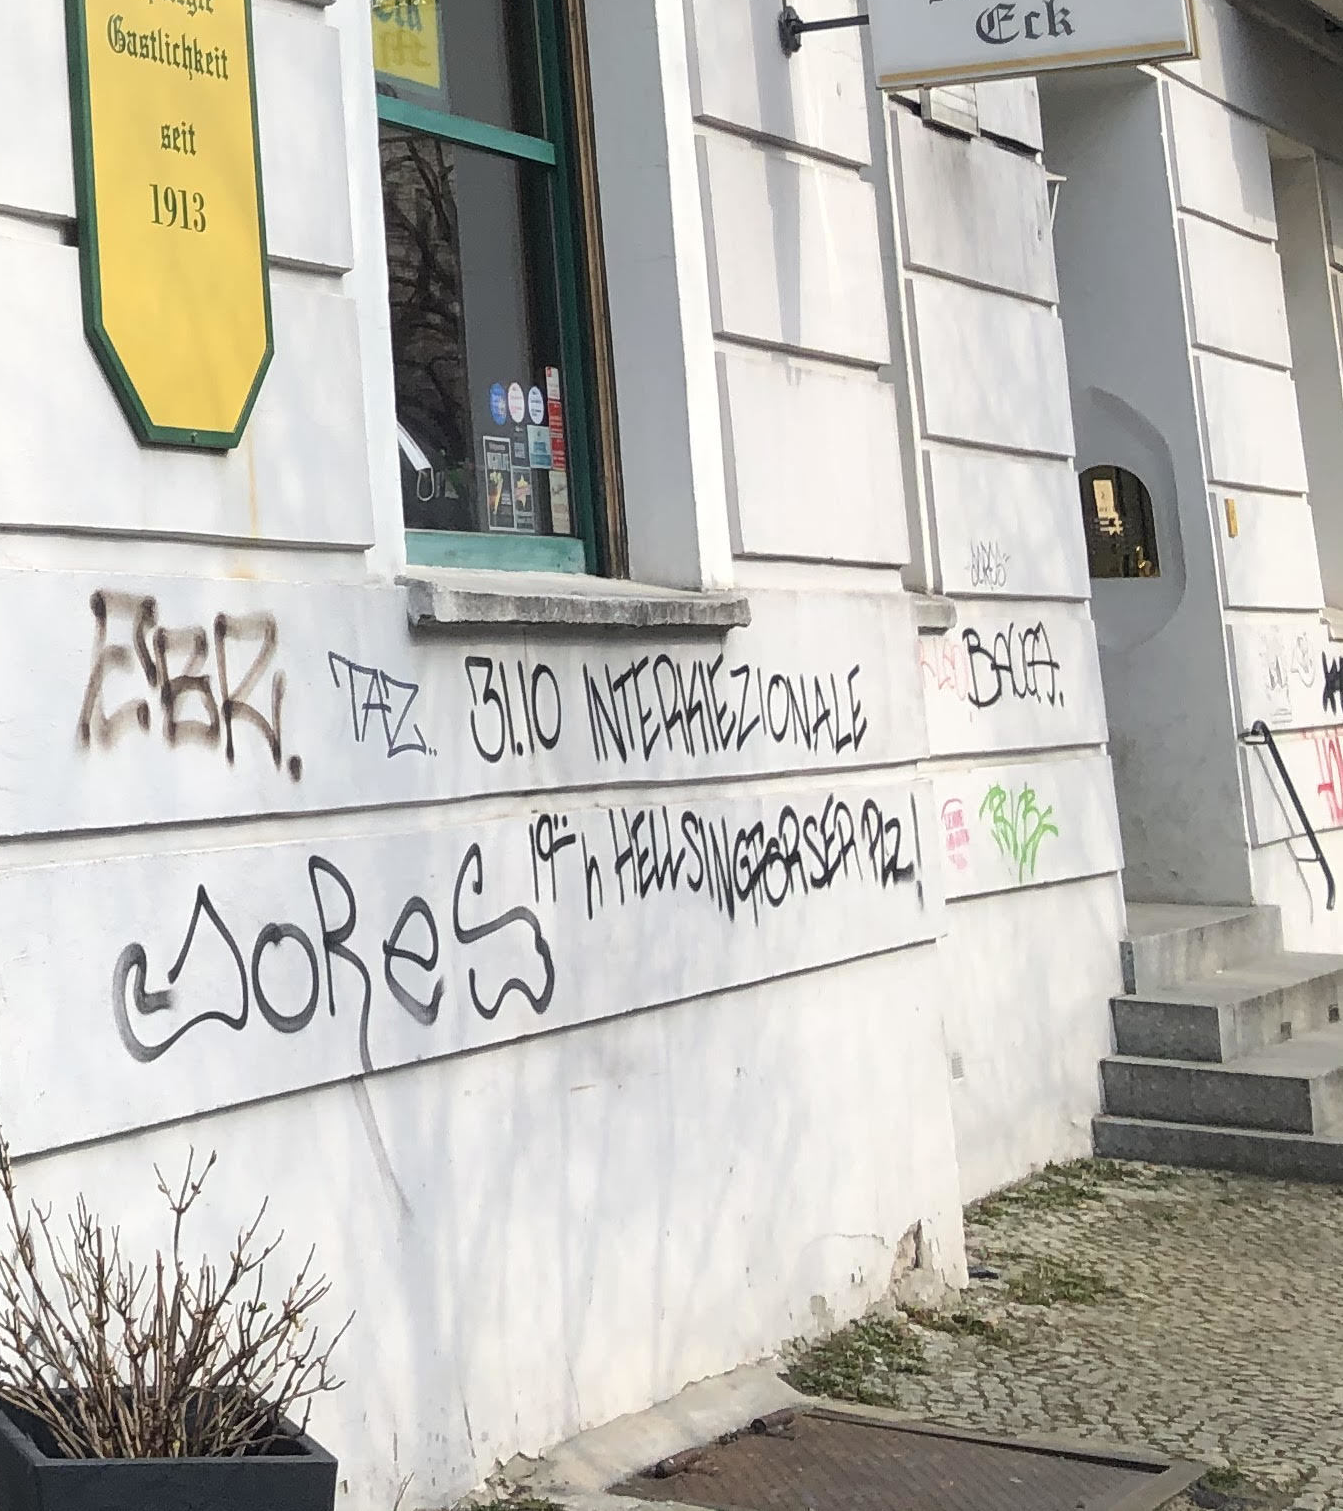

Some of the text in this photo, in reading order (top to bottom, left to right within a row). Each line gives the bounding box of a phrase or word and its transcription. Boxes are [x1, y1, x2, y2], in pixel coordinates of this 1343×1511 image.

[106, 13, 230, 81] Gastlichkeit
[159, 120, 197, 156] seit
[148, 182, 208, 233] 1913
